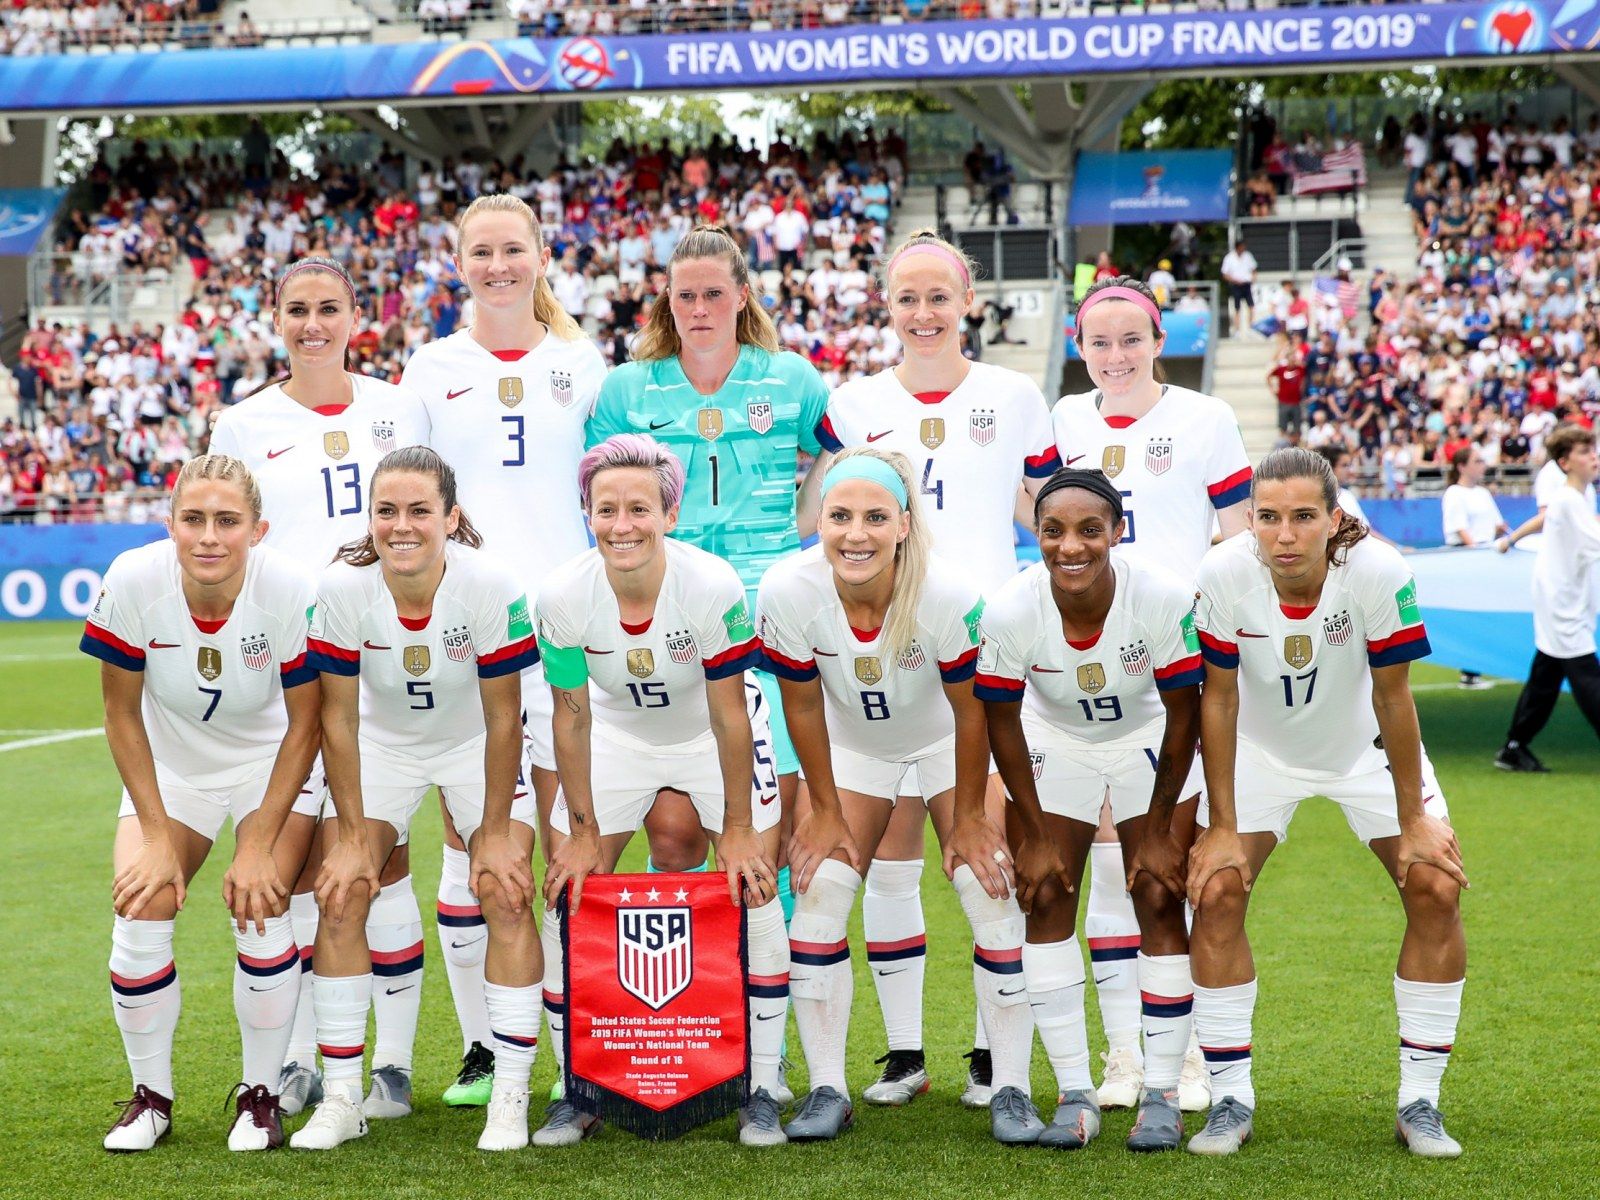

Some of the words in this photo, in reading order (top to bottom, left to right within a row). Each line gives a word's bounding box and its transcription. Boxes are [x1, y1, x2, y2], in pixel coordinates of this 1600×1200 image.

[667, 41, 743, 75] FIFA
[749, 32, 929, 72] WOMEN'S
[936, 27, 1076, 64] WORLD
[1083, 23, 1164, 59] CUP
[1172, 17, 1323, 56] FRANCE
[552, 377, 571, 391] USA
[749, 404, 770, 417] USA
[972, 417, 993, 429] USA
[374, 428, 393, 440] USA
[501, 415, 525, 467] 3
[1148, 445, 1170, 458] USA
[708, 455, 719, 506] 1
[920, 458, 943, 510] 4
[321, 462, 362, 518] 13
[1327, 617, 1349, 633] USA
[446, 633, 469, 647] USA
[669, 637, 692, 651] USA
[244, 641, 267, 655] USA
[1123, 647, 1146, 663] USA
[1279, 667, 1318, 707] 17
[406, 681, 435, 710] 5
[625, 682, 671, 708] 15
[198, 687, 222, 722] 7
[860, 691, 891, 721] 8
[1077, 695, 1123, 722] 19
[1029, 755, 1042, 765] SA
[573, 811, 585, 826] W
[623, 913, 686, 951] USA
[591, 1016, 618, 1026] United
[619, 1016, 646, 1026] States
[648, 1015, 675, 1026] Soccer
[677, 1015, 720, 1025] Federation
[591, 1029, 611, 1038] 2019
[613, 1028, 632, 1037] FIFA
[634, 1028, 674, 1037] Women's
[676, 1028, 703, 1037] World
[705, 1027, 722, 1039] Cup
[603, 1041, 644, 1050] Women's
[646, 1040, 684, 1050] National
[686, 1040, 710, 1049] Team
[630, 1055, 659, 1065] Round
[661, 1055, 671, 1065] of
[673, 1055, 683, 1065] 16
